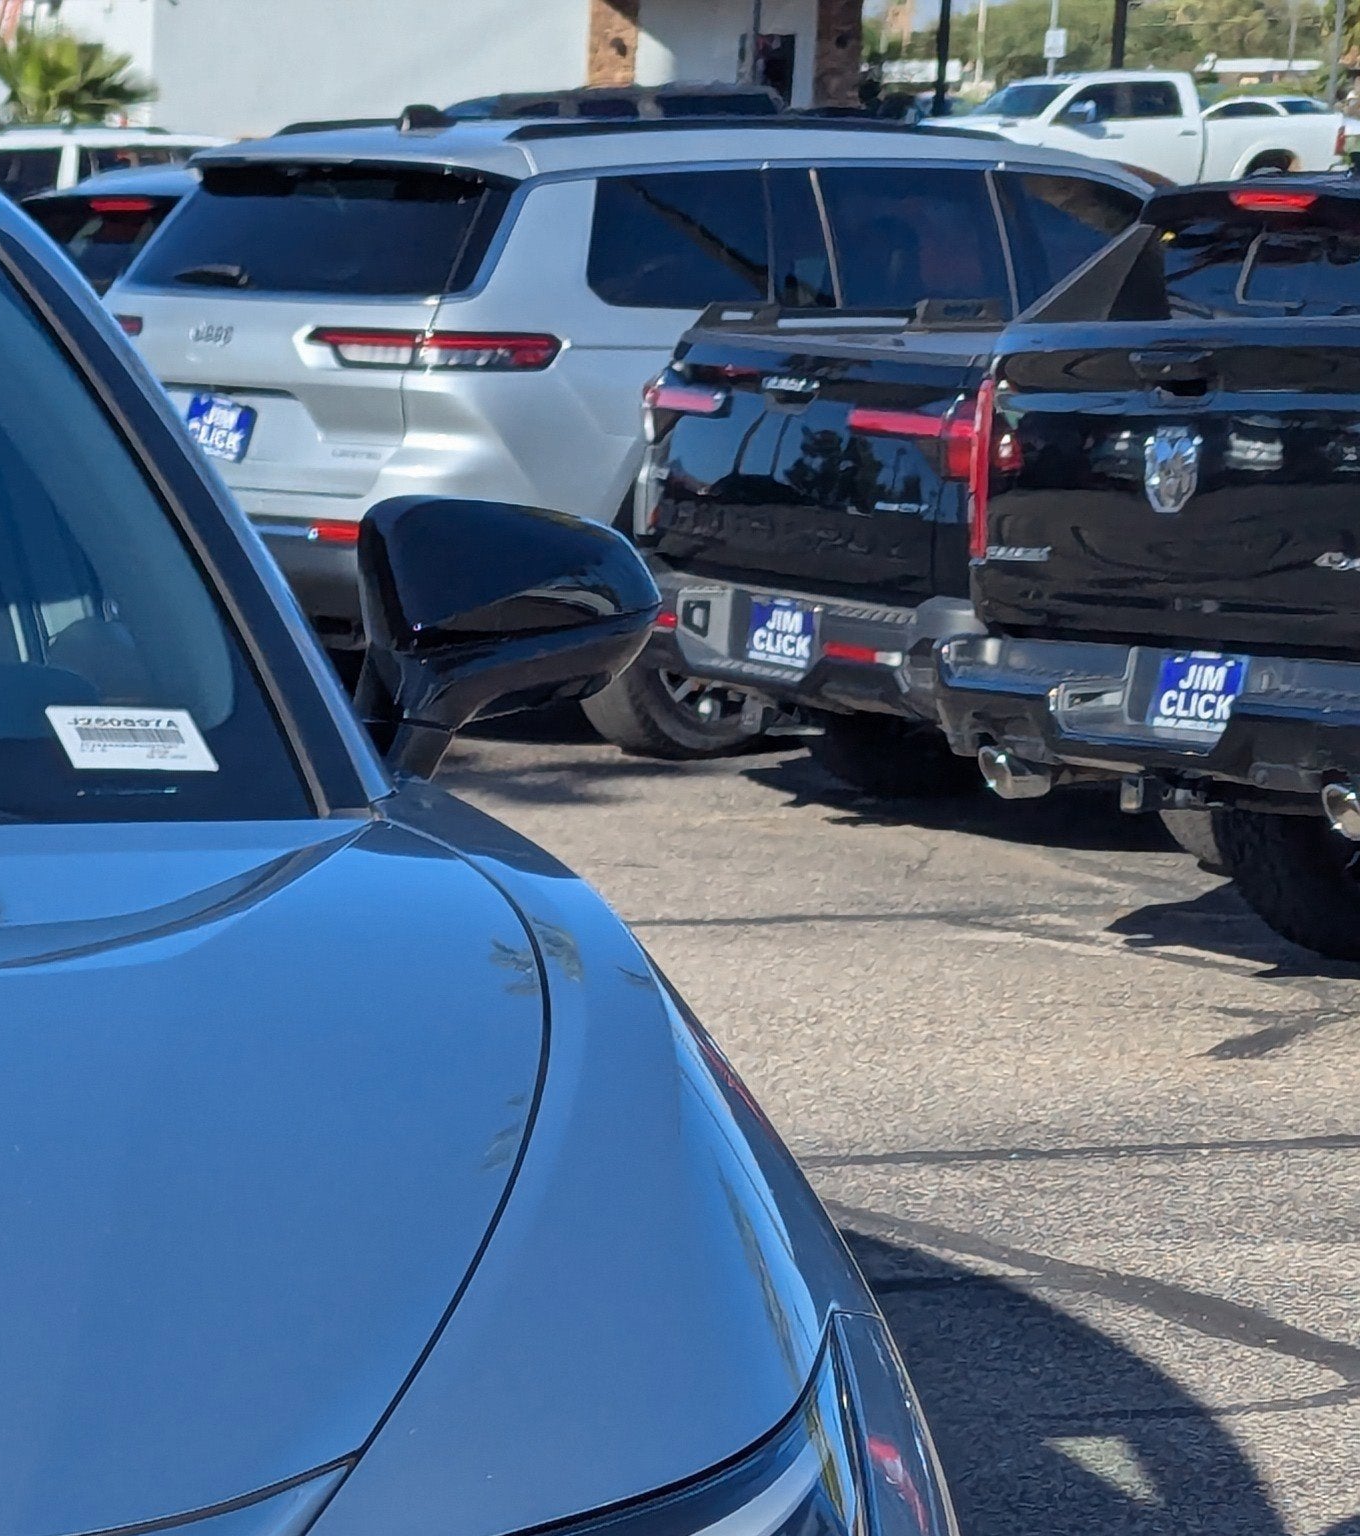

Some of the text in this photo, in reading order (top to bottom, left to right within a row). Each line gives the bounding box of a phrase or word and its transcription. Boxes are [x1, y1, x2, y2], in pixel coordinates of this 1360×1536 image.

[766, 609, 804, 634] JIM
[752, 628, 811, 659] CLICK
[1178, 664, 1227, 692] JIM
[1159, 694, 1236, 721] CLICK
